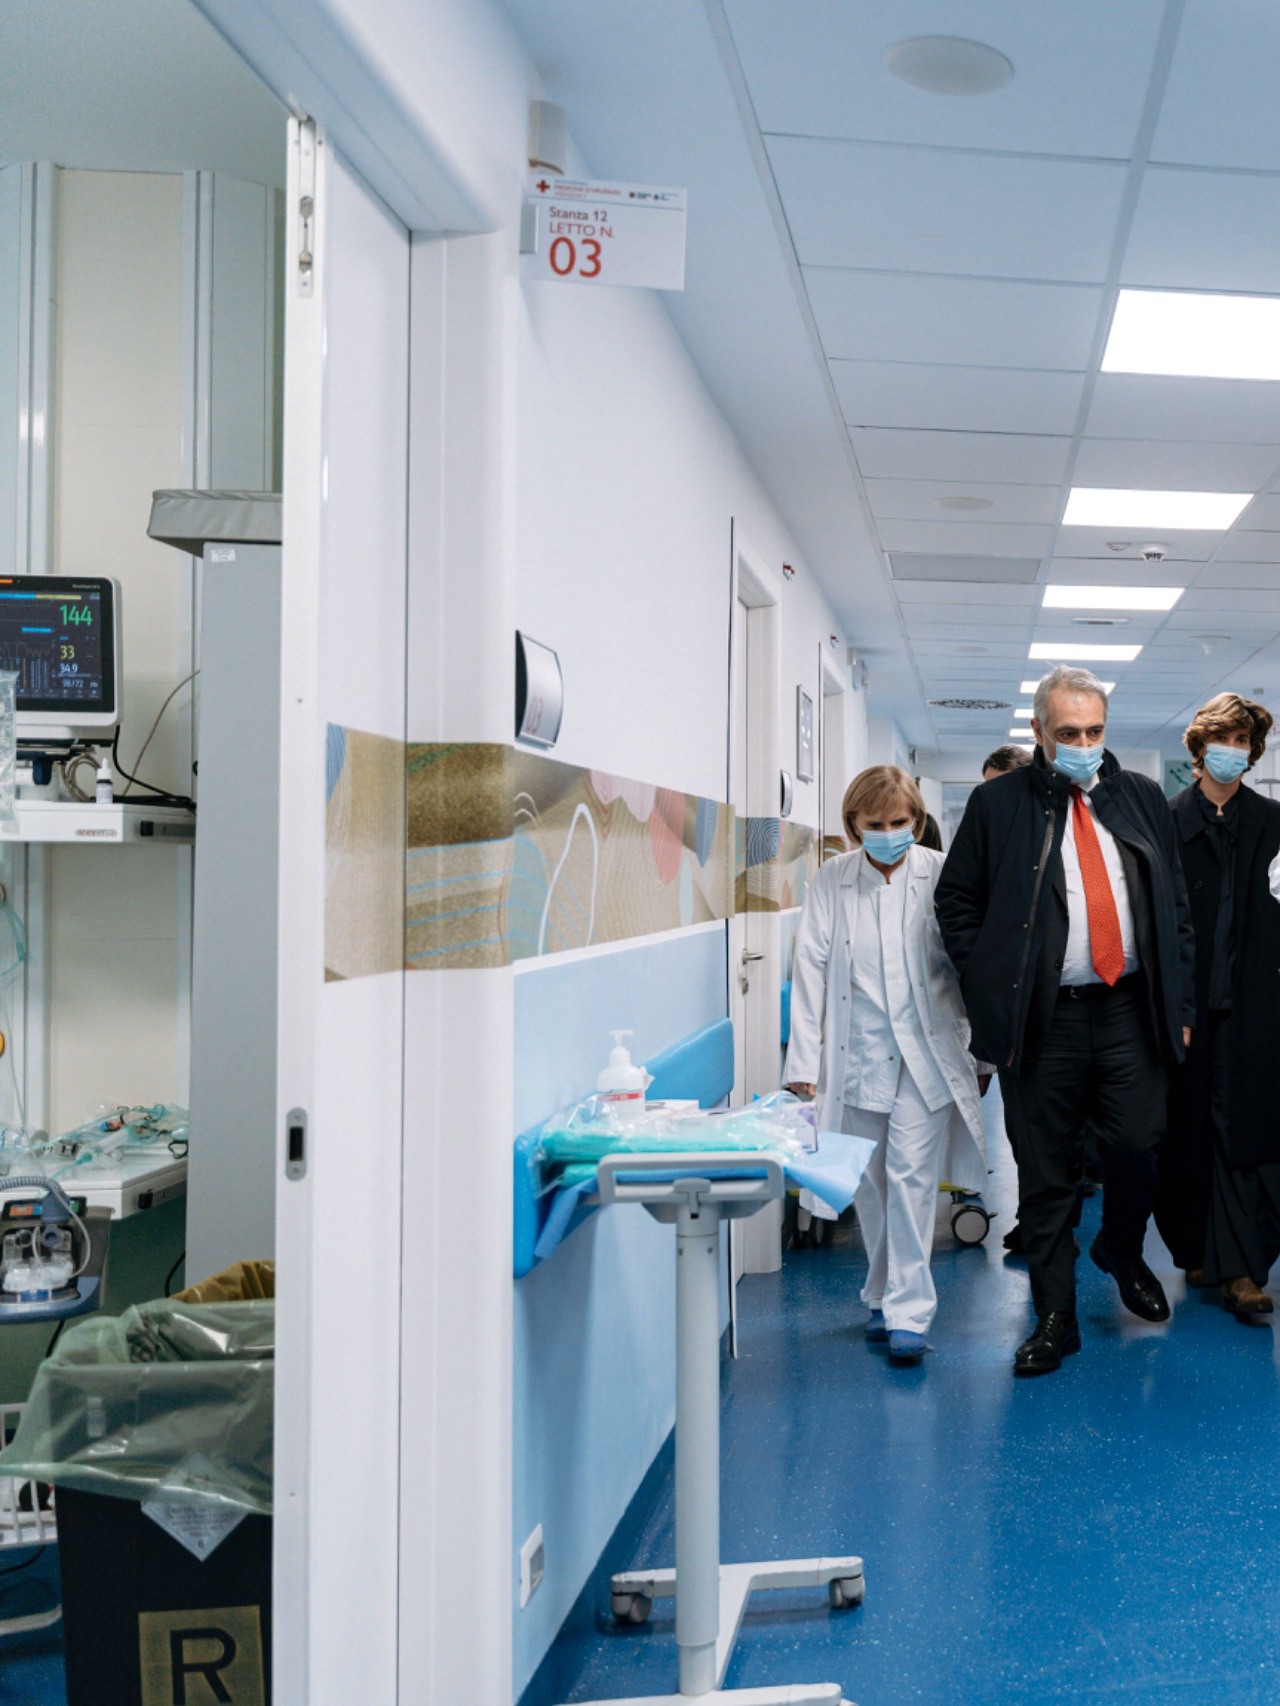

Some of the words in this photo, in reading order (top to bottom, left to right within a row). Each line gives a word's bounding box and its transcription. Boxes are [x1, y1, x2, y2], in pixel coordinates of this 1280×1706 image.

[550, 206, 588, 221] Stanza
[594, 210, 608, 222] 12
[549, 222, 596, 237] LETTO
[549, 236, 602, 278] 03
[60, 605, 93, 626] 144
[60, 645, 75, 660] 33
[170, 1626, 237, 1706] R
